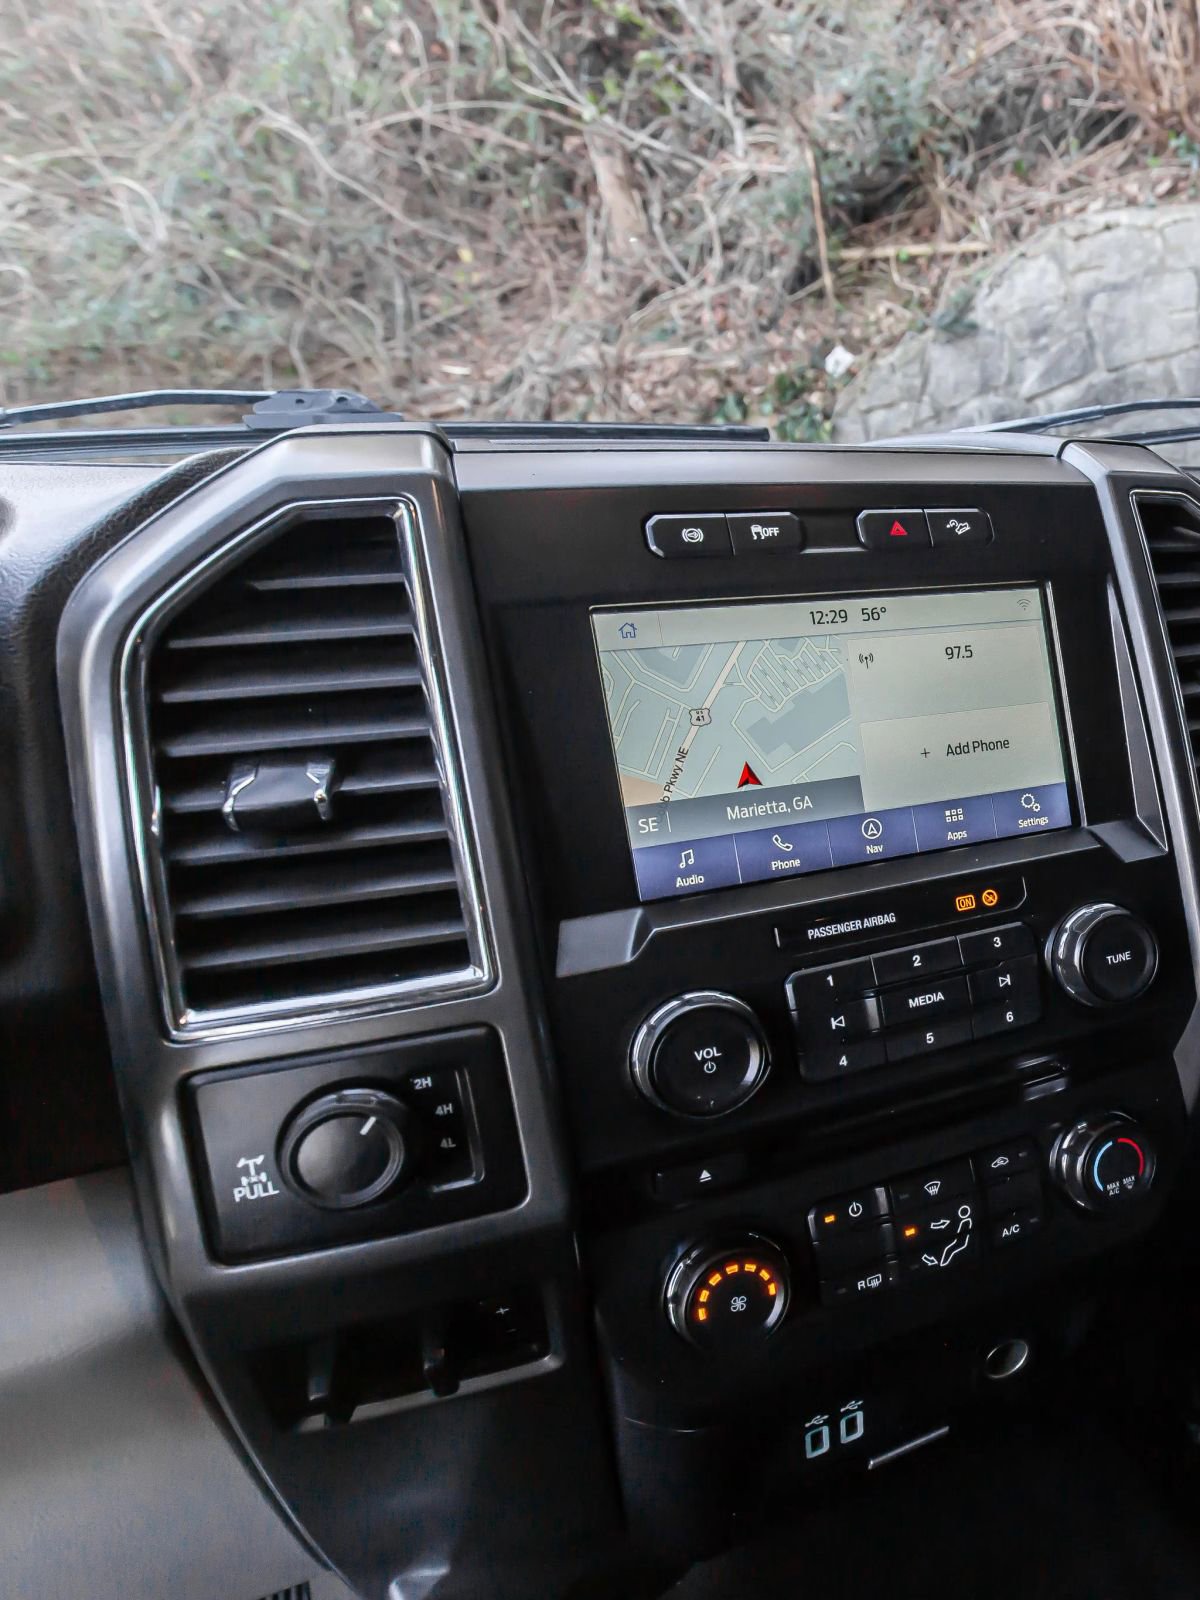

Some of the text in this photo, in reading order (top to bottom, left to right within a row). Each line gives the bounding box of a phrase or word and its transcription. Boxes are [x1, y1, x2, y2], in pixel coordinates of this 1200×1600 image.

[762, 526, 780, 538] OFF
[809, 609, 849, 626] 12:29
[861, 606, 888, 623] 56°
[945, 644, 974, 661] 97.5
[946, 738, 1010, 757] Add Phone
[663, 764, 684, 794] Pkwy
[674, 746, 689, 764] NE
[726, 795, 813, 821] Marietta, GA
[638, 816, 659, 834] SE
[1018, 816, 1049, 829] Settings
[947, 831, 968, 843] Apps
[866, 844, 883, 855] Nav
[771, 858, 801, 871] Phone
[675, 874, 705, 888] Audio
[959, 897, 973, 909] ON
[807, 912, 897, 940] PASSENGER AIRBAG
[993, 936, 1002, 948] 3
[912, 954, 922, 967] 2
[1105, 950, 1132, 965] TUNE
[826, 974, 834, 987] 1
[908, 991, 945, 1008] MEDIA
[1006, 1011, 1014, 1022] 6
[926, 1032, 935, 1044] 5
[694, 1046, 722, 1061] VOL
[838, 1055, 848, 1067] 4
[413, 1076, 432, 1090] 2H
[435, 1103, 453, 1116] 4H
[439, 1138, 456, 1149] 4L
[232, 1183, 280, 1202] PULL
[1106, 1181, 1120, 1191] MAX
[1108, 1187, 1120, 1196] A/C
[1002, 1223, 1021, 1238] A/C
